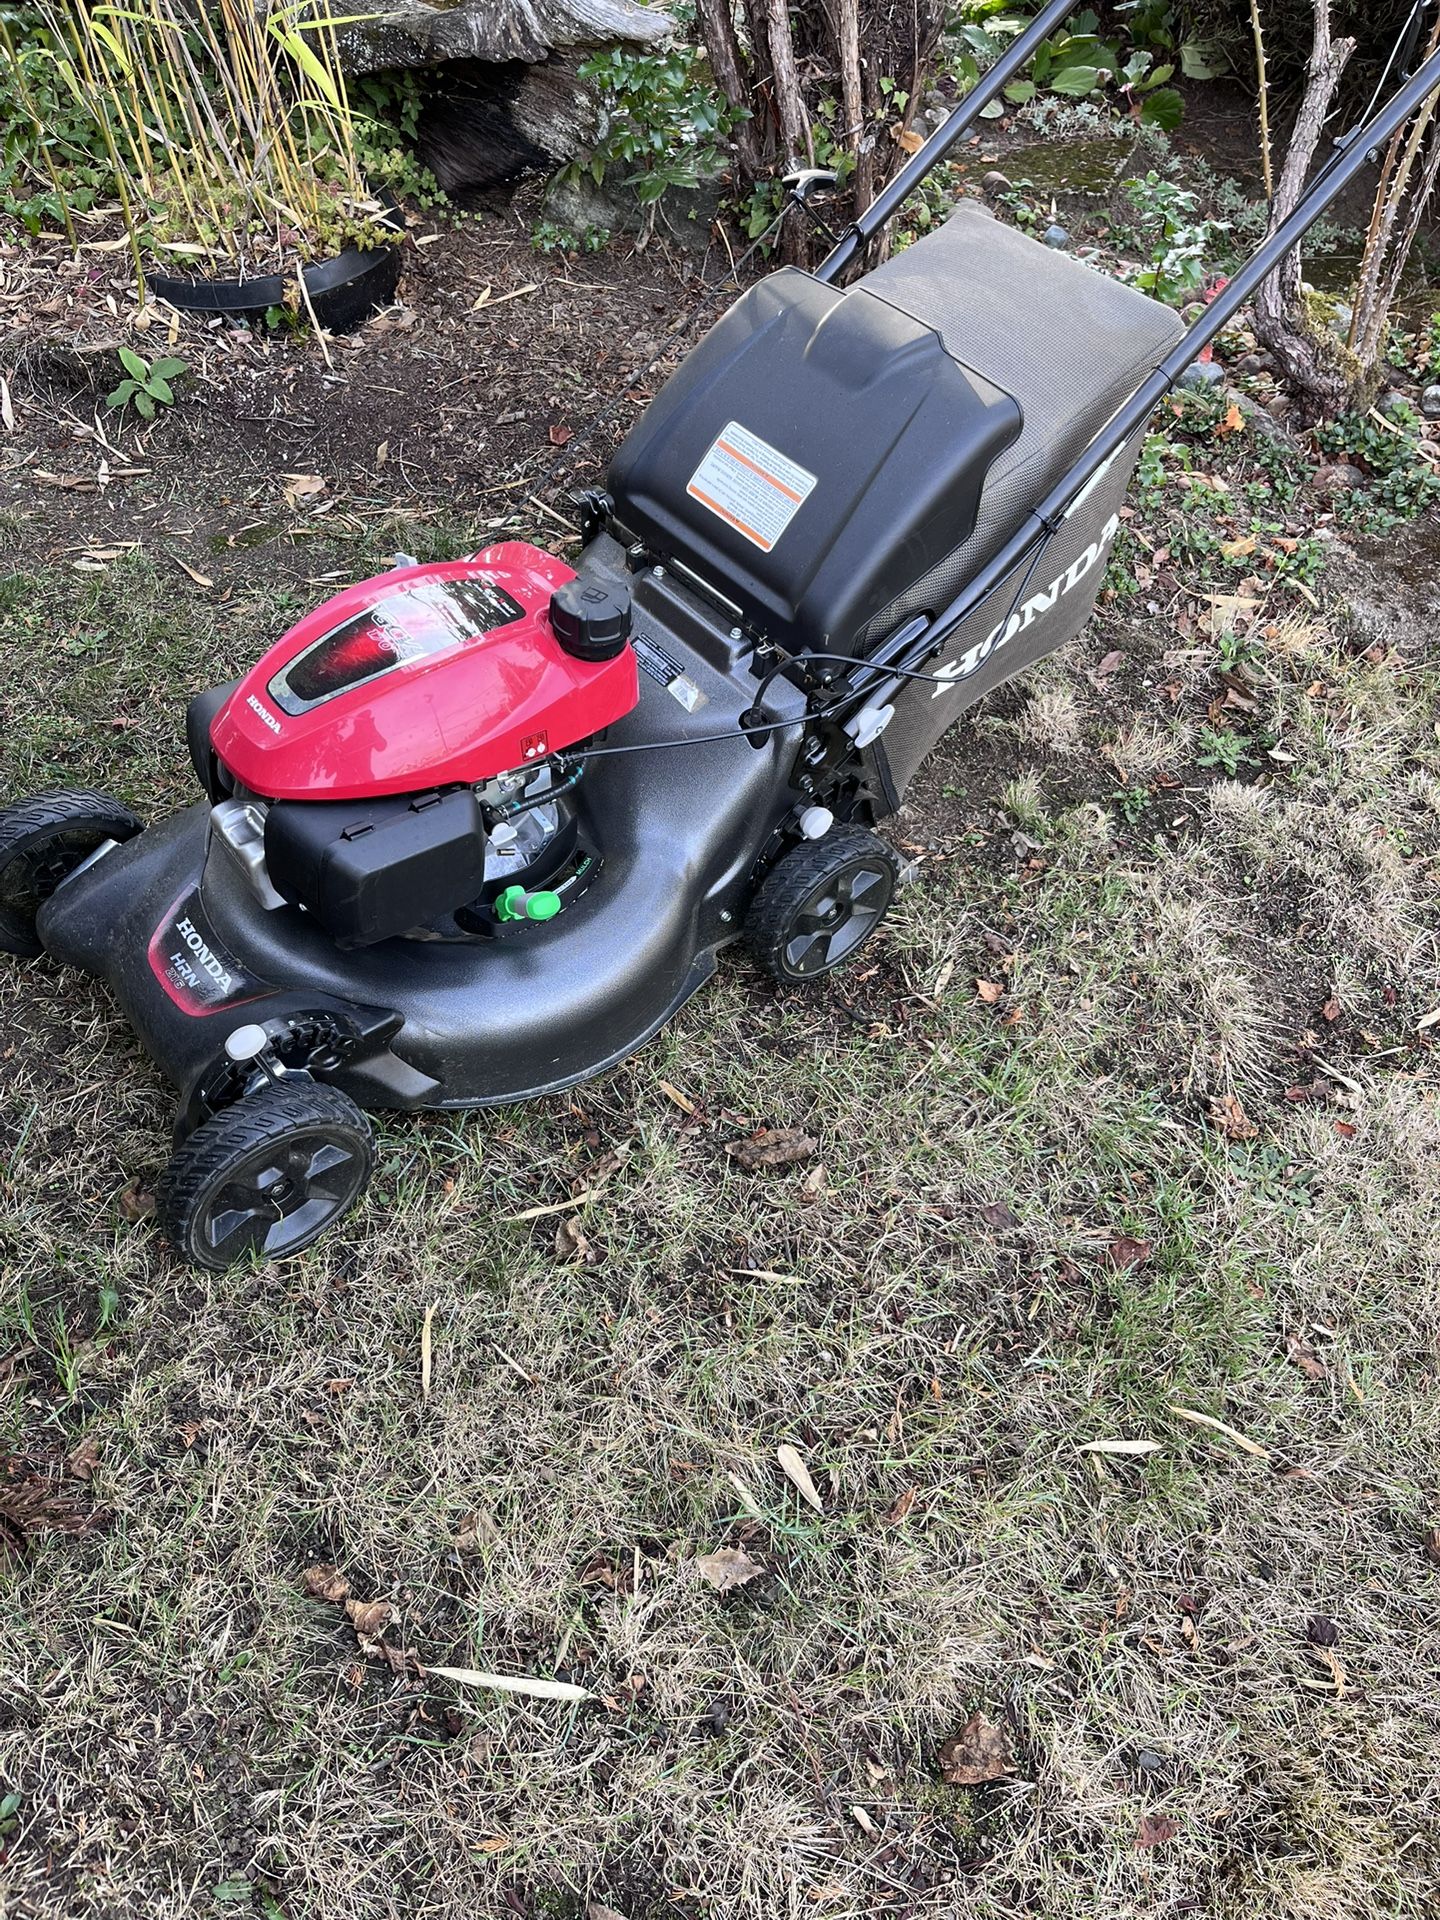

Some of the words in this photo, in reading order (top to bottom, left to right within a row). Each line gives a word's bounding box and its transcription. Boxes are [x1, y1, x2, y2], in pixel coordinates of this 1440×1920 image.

[932, 513, 1120, 699] HONDA
[246, 694, 281, 734] HONDA
[170, 952, 200, 988] HRN
[176, 917, 233, 994] HONDA
[165, 967, 186, 989] 216
